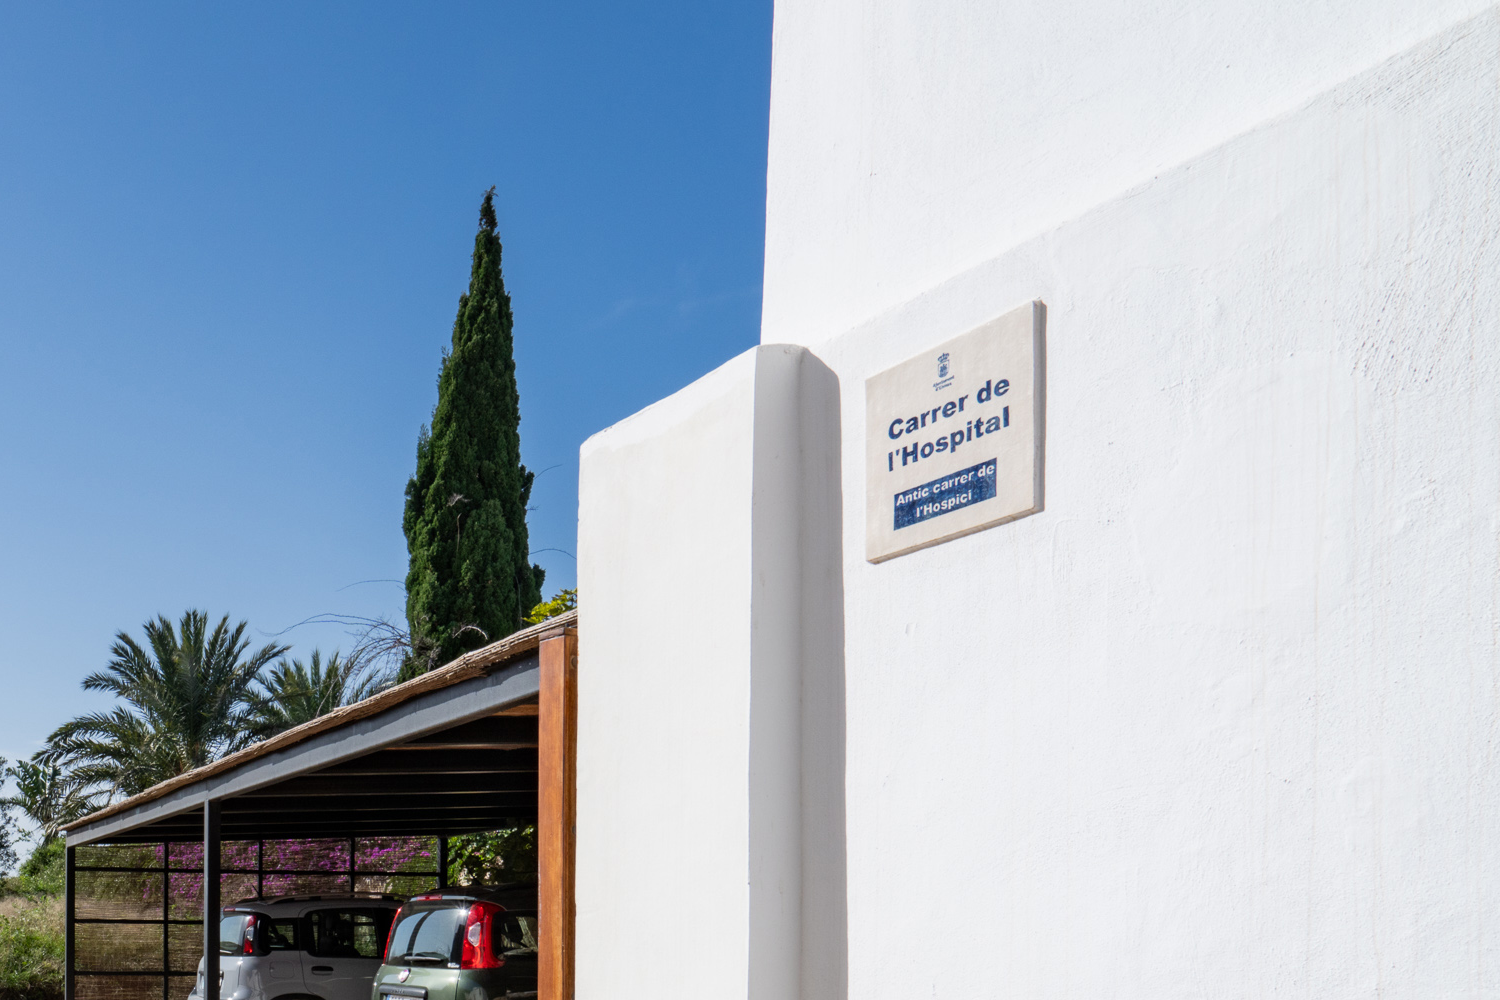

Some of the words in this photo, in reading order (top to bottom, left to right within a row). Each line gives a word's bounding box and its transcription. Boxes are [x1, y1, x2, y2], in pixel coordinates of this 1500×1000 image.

[888, 394, 969, 440] Carrer
[976, 378, 1010, 404] de
[888, 405, 1010, 472] l'Hospital
[896, 487, 929, 506] Antic
[933, 471, 975, 494] carrer
[977, 464, 995, 478] de
[916, 489, 972, 518] l'Hospici
